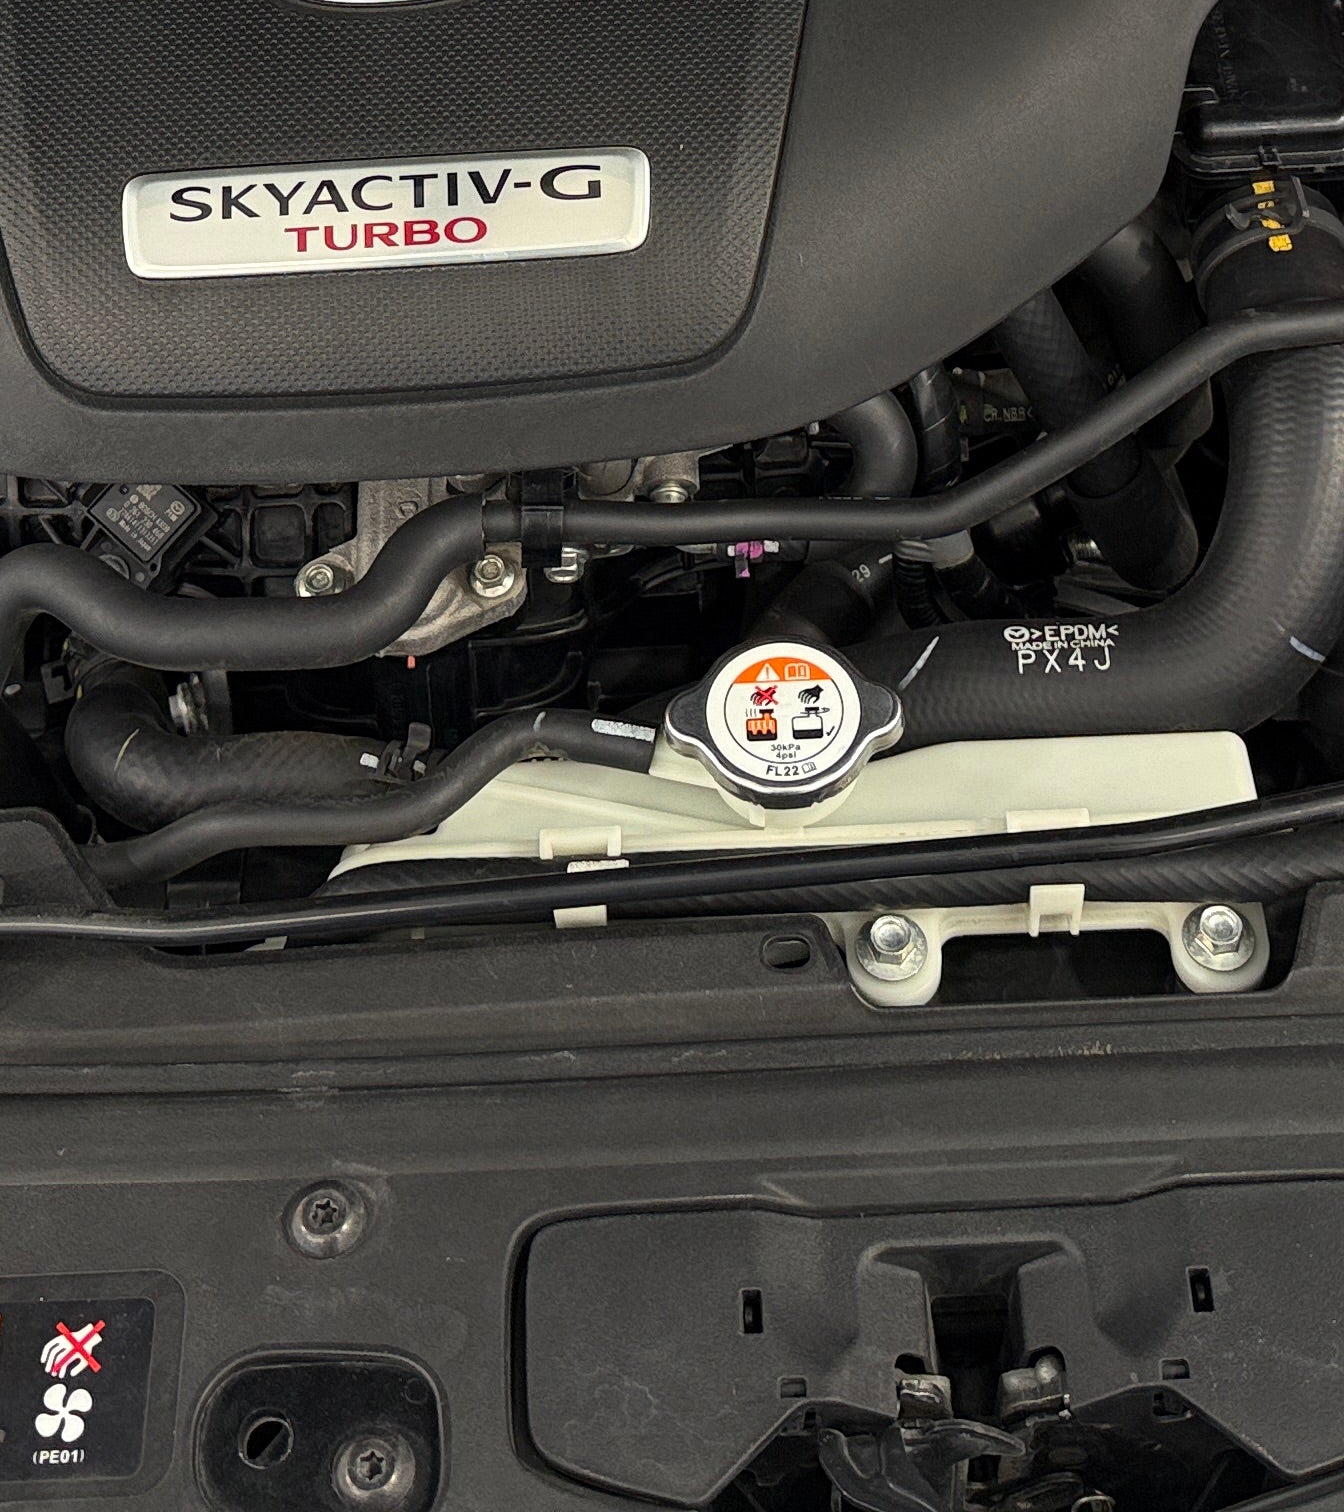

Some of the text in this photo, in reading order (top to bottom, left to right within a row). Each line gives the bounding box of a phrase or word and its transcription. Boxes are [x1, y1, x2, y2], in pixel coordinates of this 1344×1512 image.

[168, 164, 604, 223] SKYACTIV-G
[282, 215, 489, 254] TURBO
[851, 563, 872, 584] 29
[1011, 637, 1115, 651] MADE IN CHINA
[1017, 647, 1112, 675] PX4J
[770, 743, 801, 752] 30kPa
[775, 751, 797, 760] 4psi
[765, 764, 800, 776] FL22
[32, 1448, 85, 1465] (PE01)
